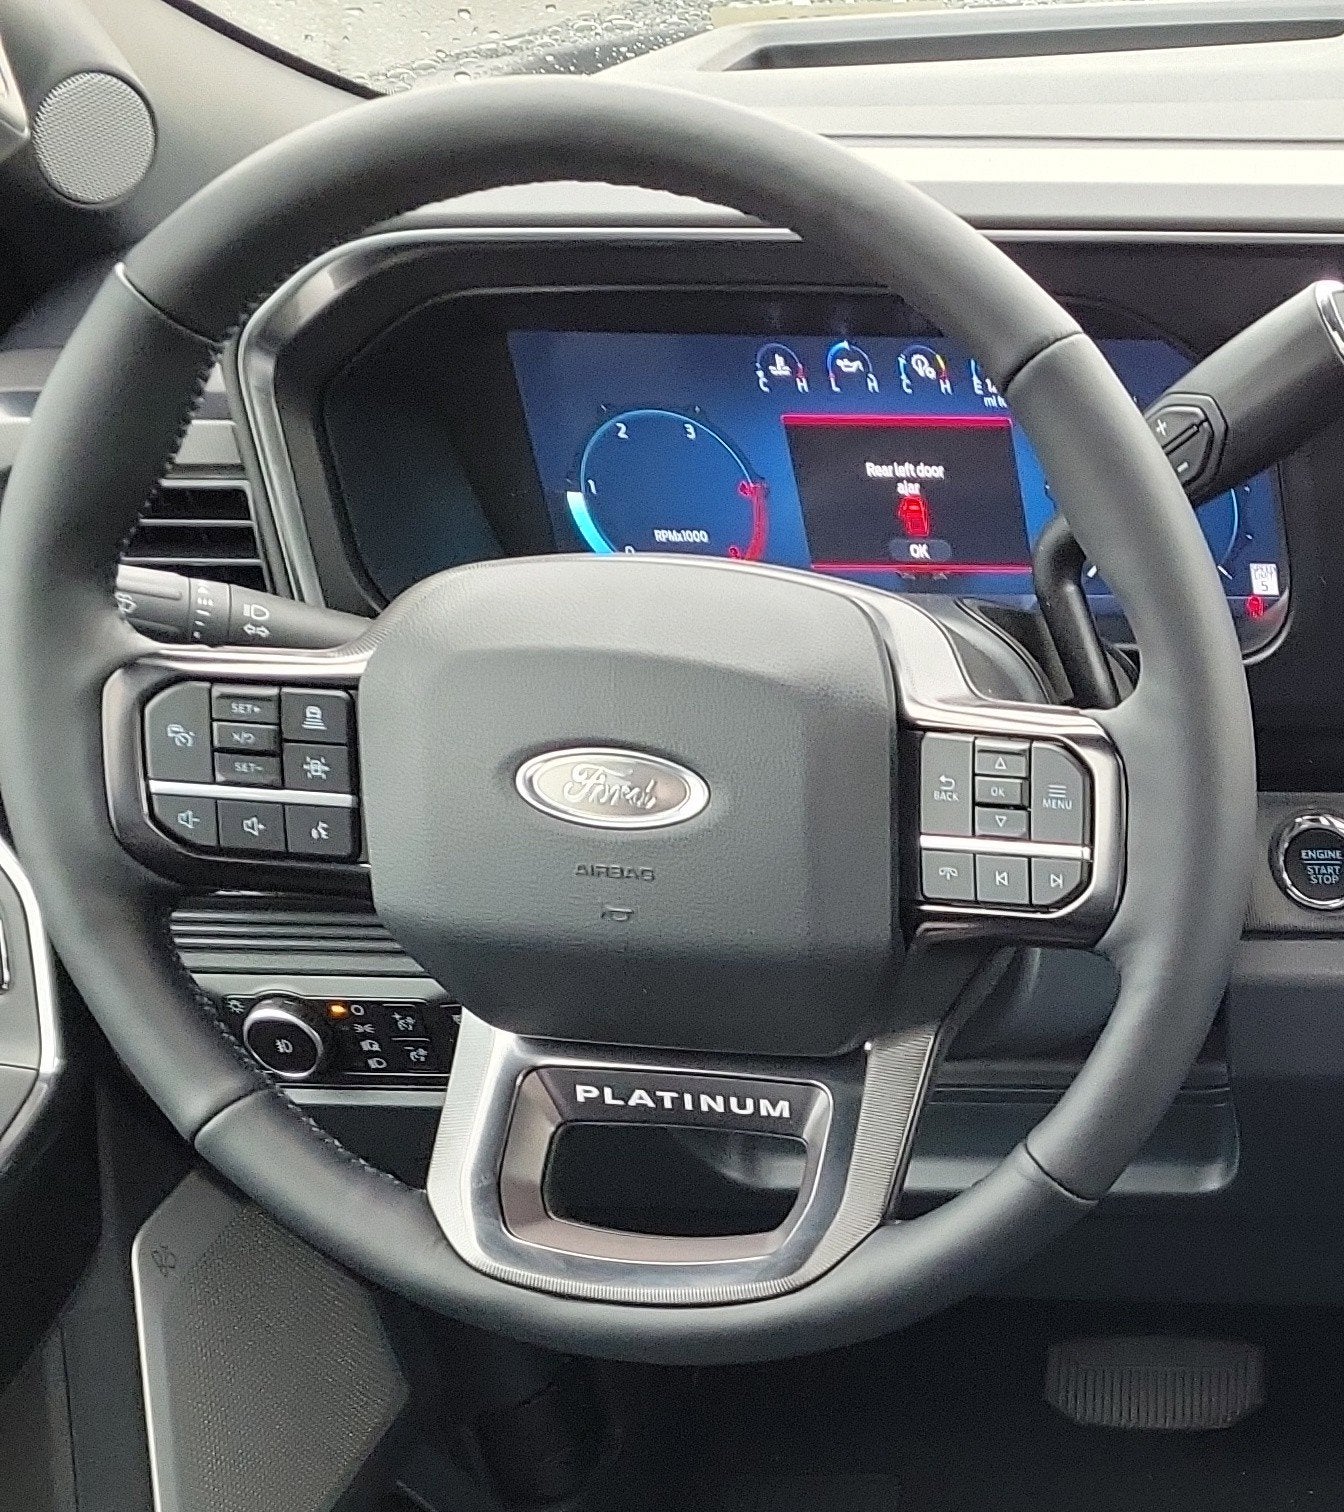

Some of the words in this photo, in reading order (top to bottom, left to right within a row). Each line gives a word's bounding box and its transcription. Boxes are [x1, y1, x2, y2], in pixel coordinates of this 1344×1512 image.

[796, 378, 809, 393] H
[940, 379, 952, 395] H
[617, 423, 629, 439] 2
[685, 424, 696, 440] 3
[866, 462, 894, 479] Rear
[894, 462, 917, 480] left
[917, 463, 945, 480] door
[588, 480, 598, 495] 1
[897, 480, 921, 497] ajar
[909, 543, 931, 560] OK
[563, 763, 657, 810] Ford
[990, 788, 1005, 798] OK
[933, 790, 960, 802] BACK
[1042, 798, 1073, 810] MENU
[1301, 849, 1343, 860] ENGINE
[1307, 865, 1341, 875] START
[1310, 874, 1340, 885] STOP
[575, 1083, 791, 1119] PLATINUM
